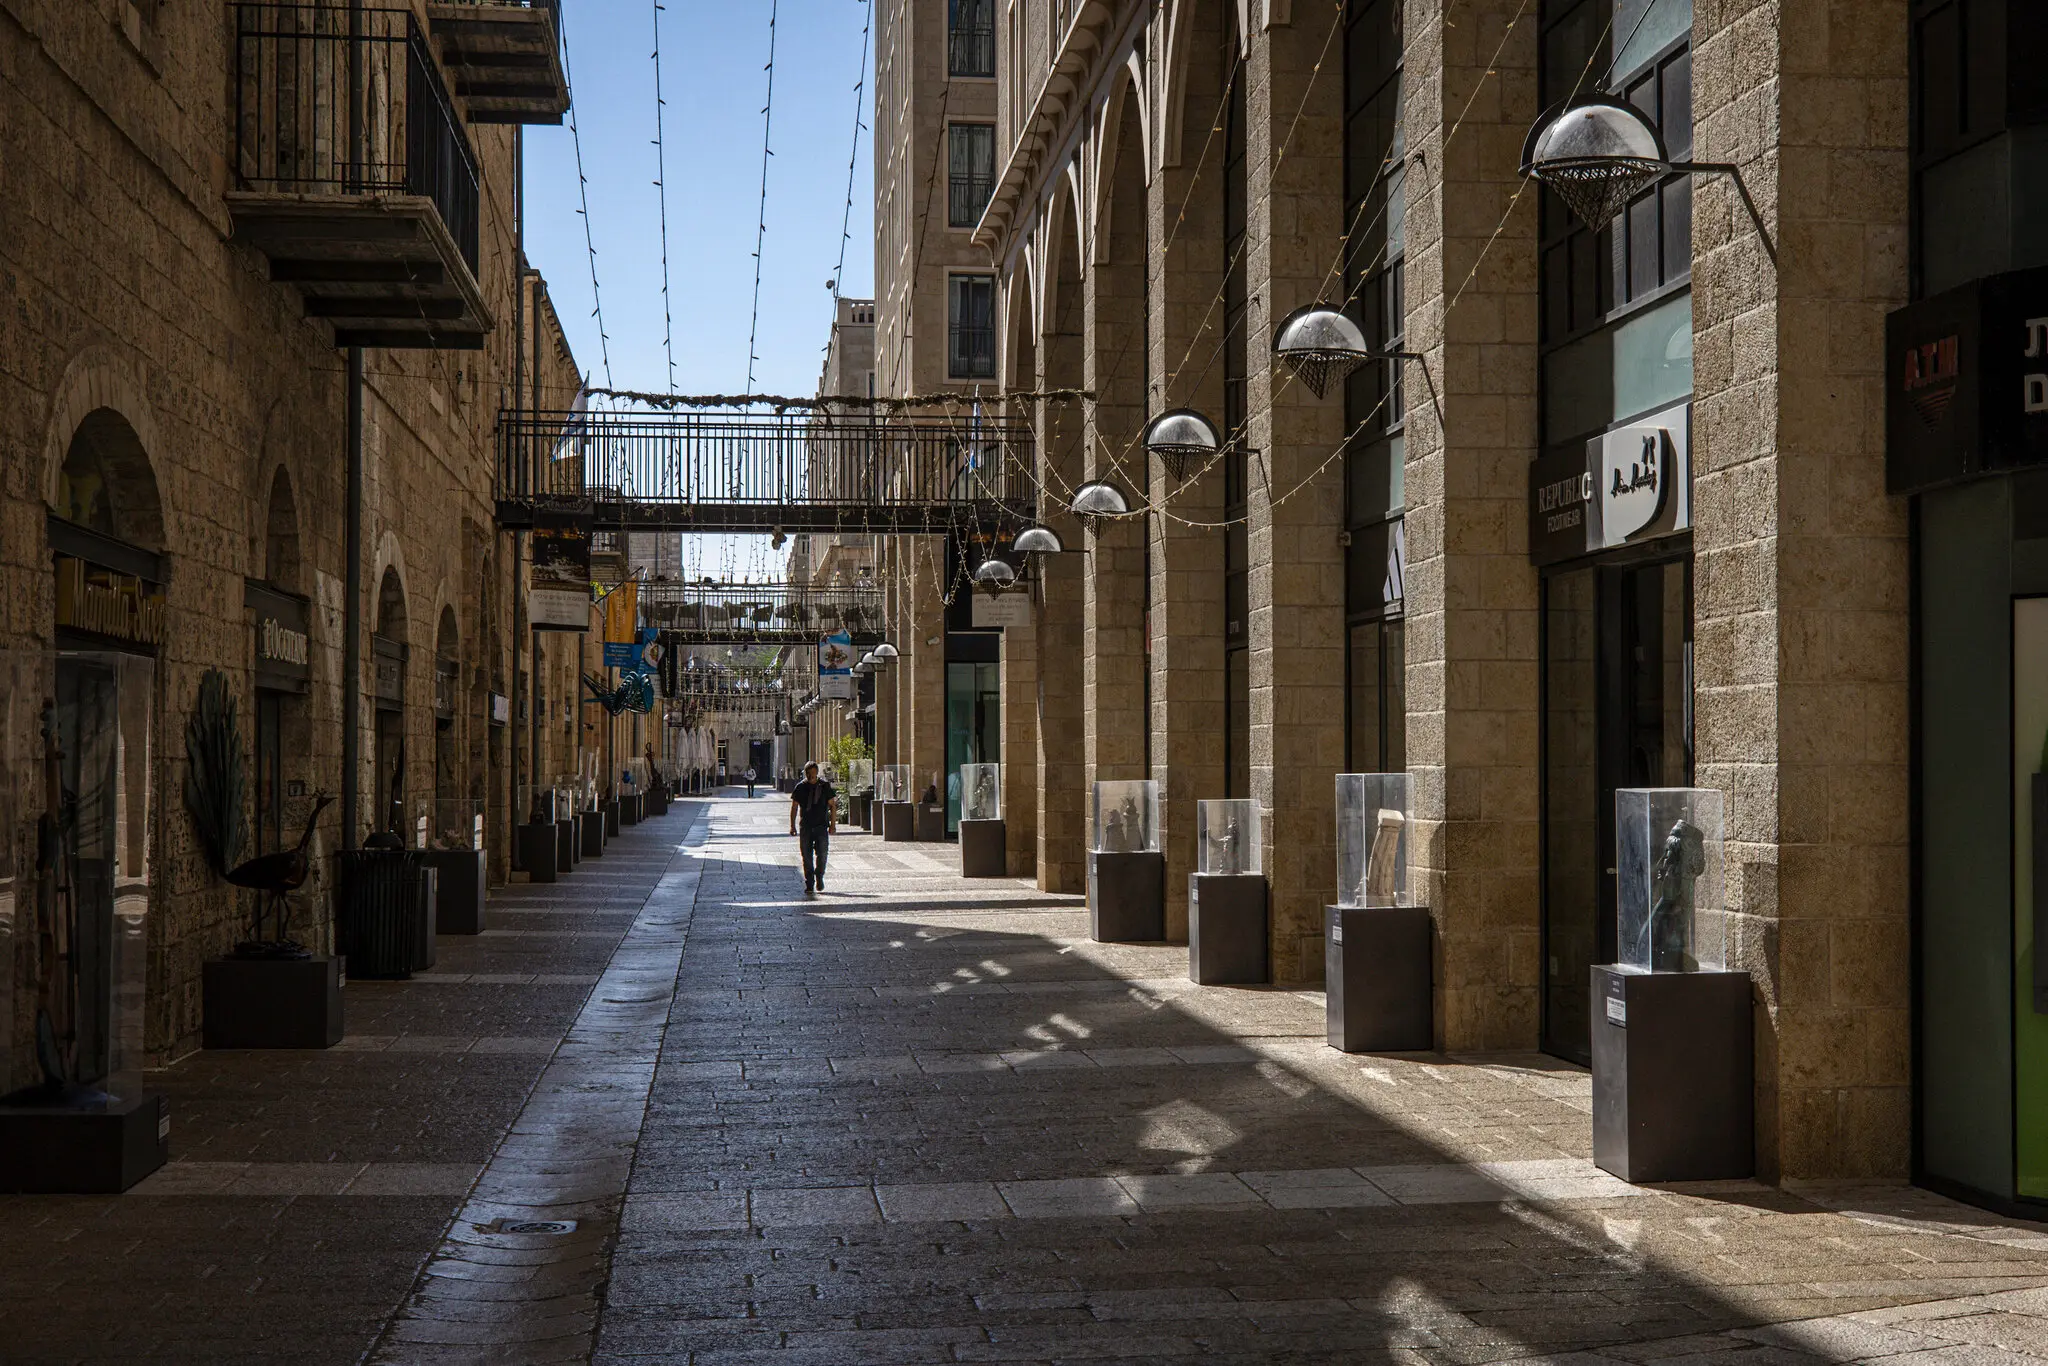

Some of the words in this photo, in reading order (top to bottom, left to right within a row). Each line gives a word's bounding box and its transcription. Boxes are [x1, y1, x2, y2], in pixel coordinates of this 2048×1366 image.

[1539, 471, 1593, 514] REPUBLIC
[1547, 508, 1581, 534] FOOTWEAR
[71, 557, 130, 640] Mamilla
[134, 575, 166, 646] Swee
